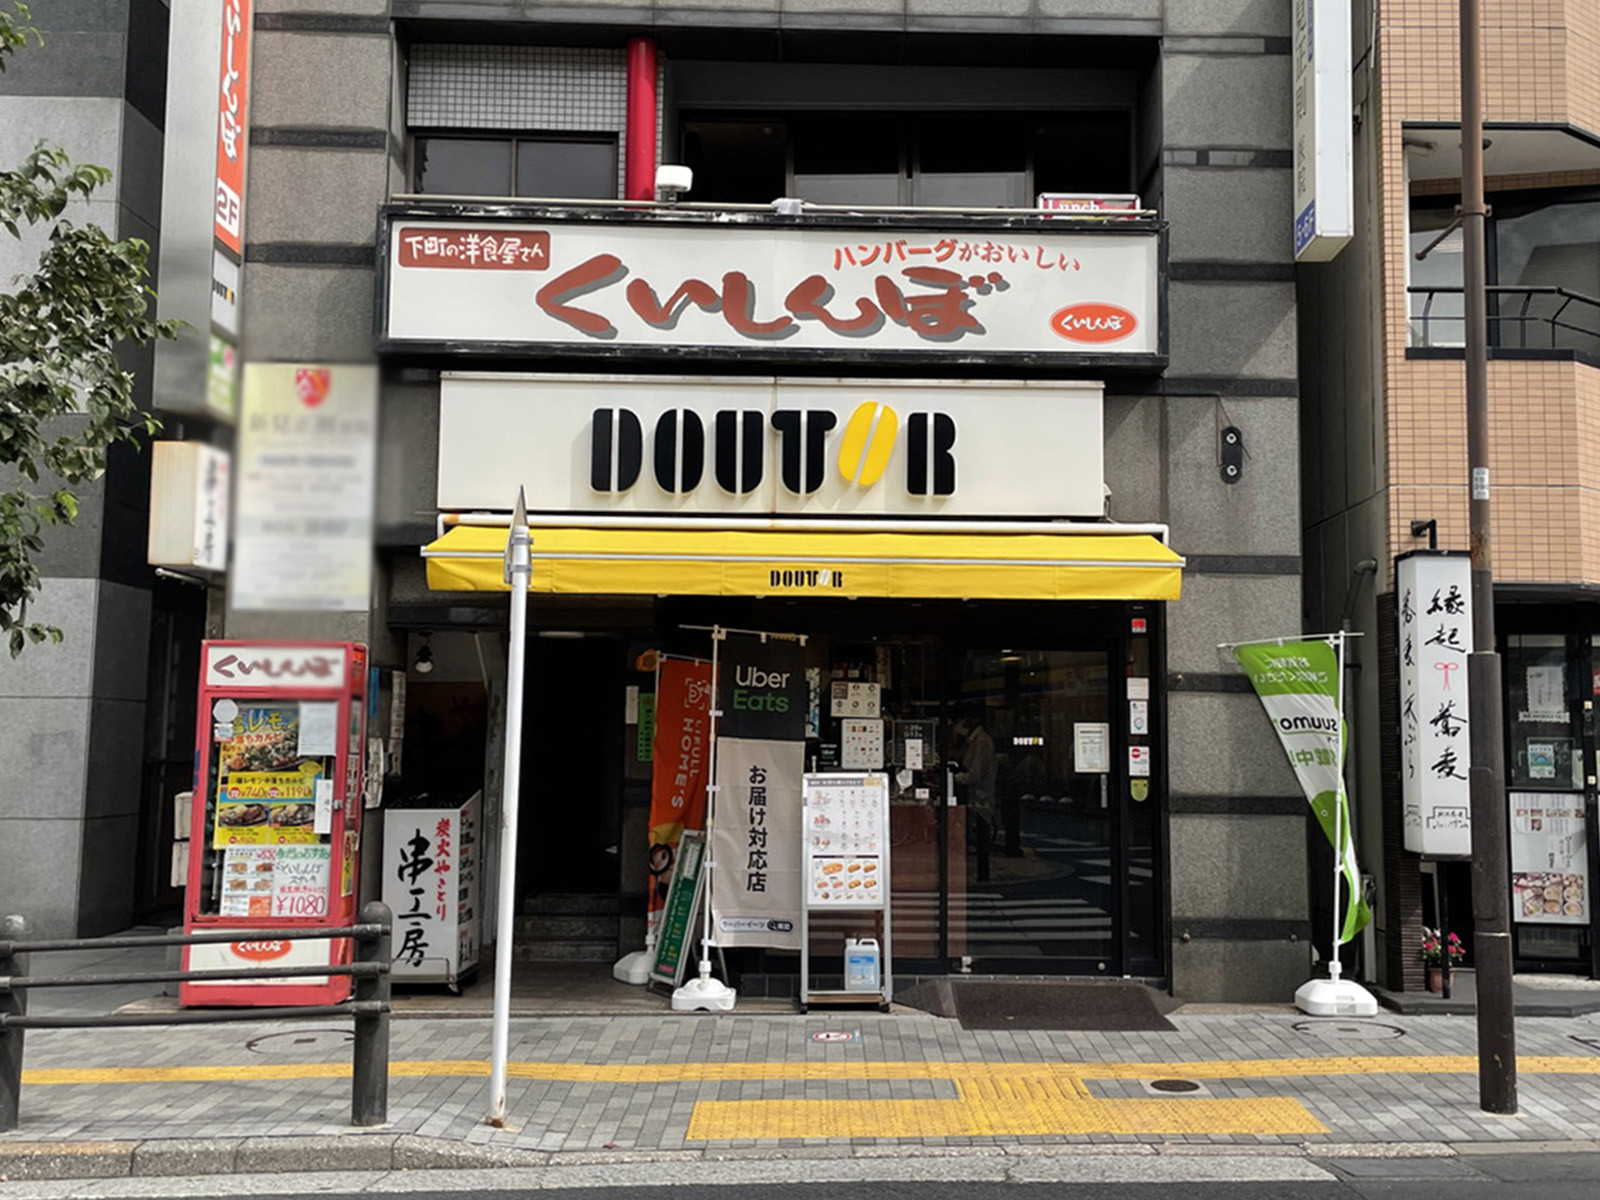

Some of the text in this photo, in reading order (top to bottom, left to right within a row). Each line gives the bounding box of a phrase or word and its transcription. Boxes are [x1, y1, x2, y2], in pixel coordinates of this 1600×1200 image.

[221, 0, 241, 162] いしんぼ
[216, 185, 239, 226] 2F
[404, 234, 544, 266] 下町の洋食屋さん
[833, 238, 1081, 272] ハンバーグがおいしい
[535, 253, 1010, 343] くいしんぼ
[1060, 314, 1126, 332] くいしんぼ
[590, 400, 957, 496] DOUTOR
[769, 567, 843, 588] DOUTOR
[733, 689, 789, 713] Eats
[735, 665, 790, 689] Uber
[671, 717, 694, 809] HOME'S
[747, 765, 768, 893] お届け対応店
[397, 828, 434, 967] 串工房
[434, 817, 451, 922] 炭火やきとり
